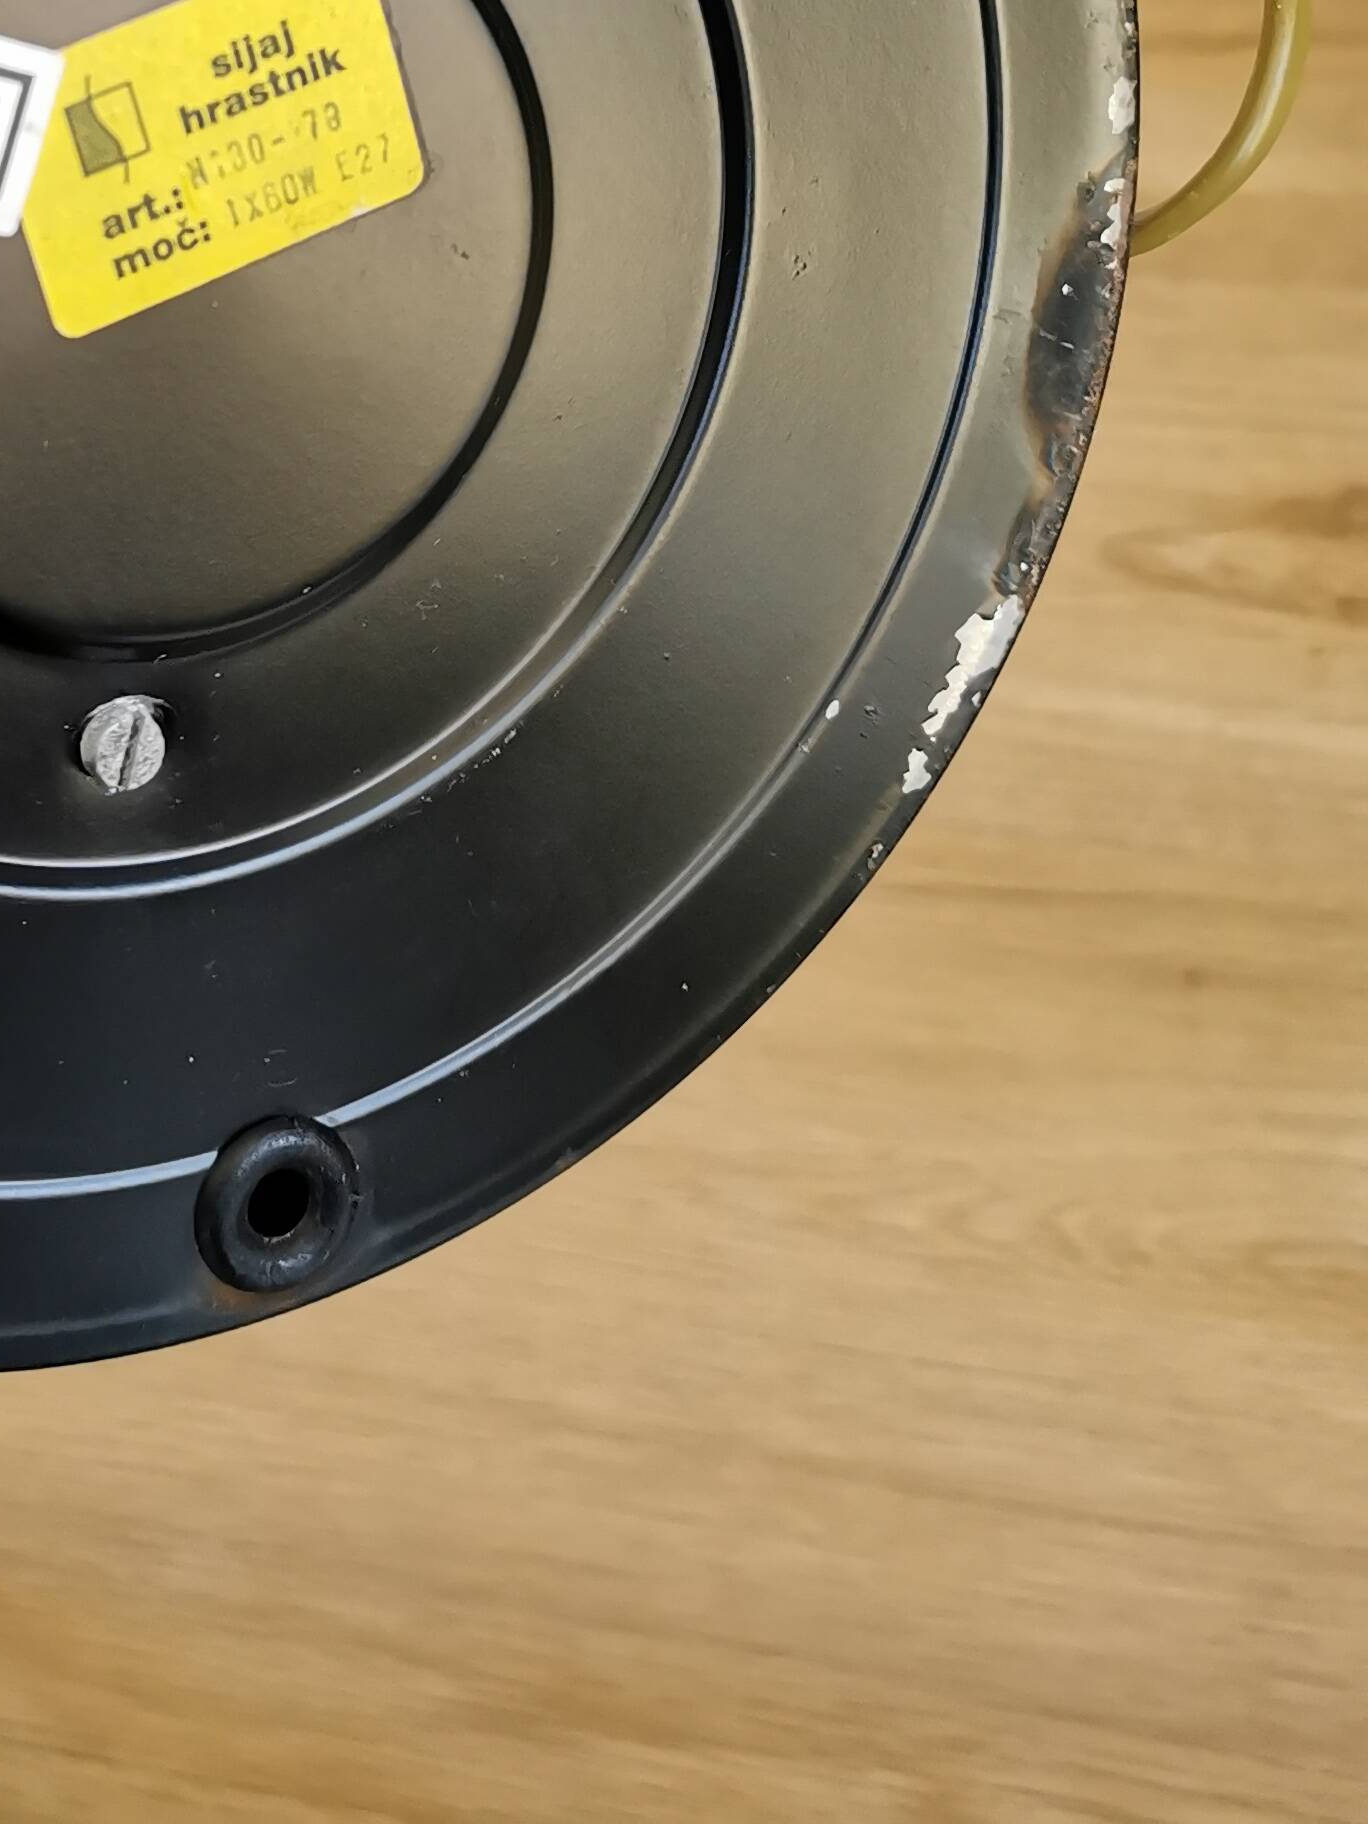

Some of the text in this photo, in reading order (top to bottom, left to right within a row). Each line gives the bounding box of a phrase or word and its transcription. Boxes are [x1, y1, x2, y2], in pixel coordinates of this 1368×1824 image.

[211, 18, 296, 78] sijaj
[178, 47, 347, 135] hrastnik
[102, 187, 184, 240] art.:
[113, 217, 212, 280] moč:
[335, 132, 391, 183] E27
